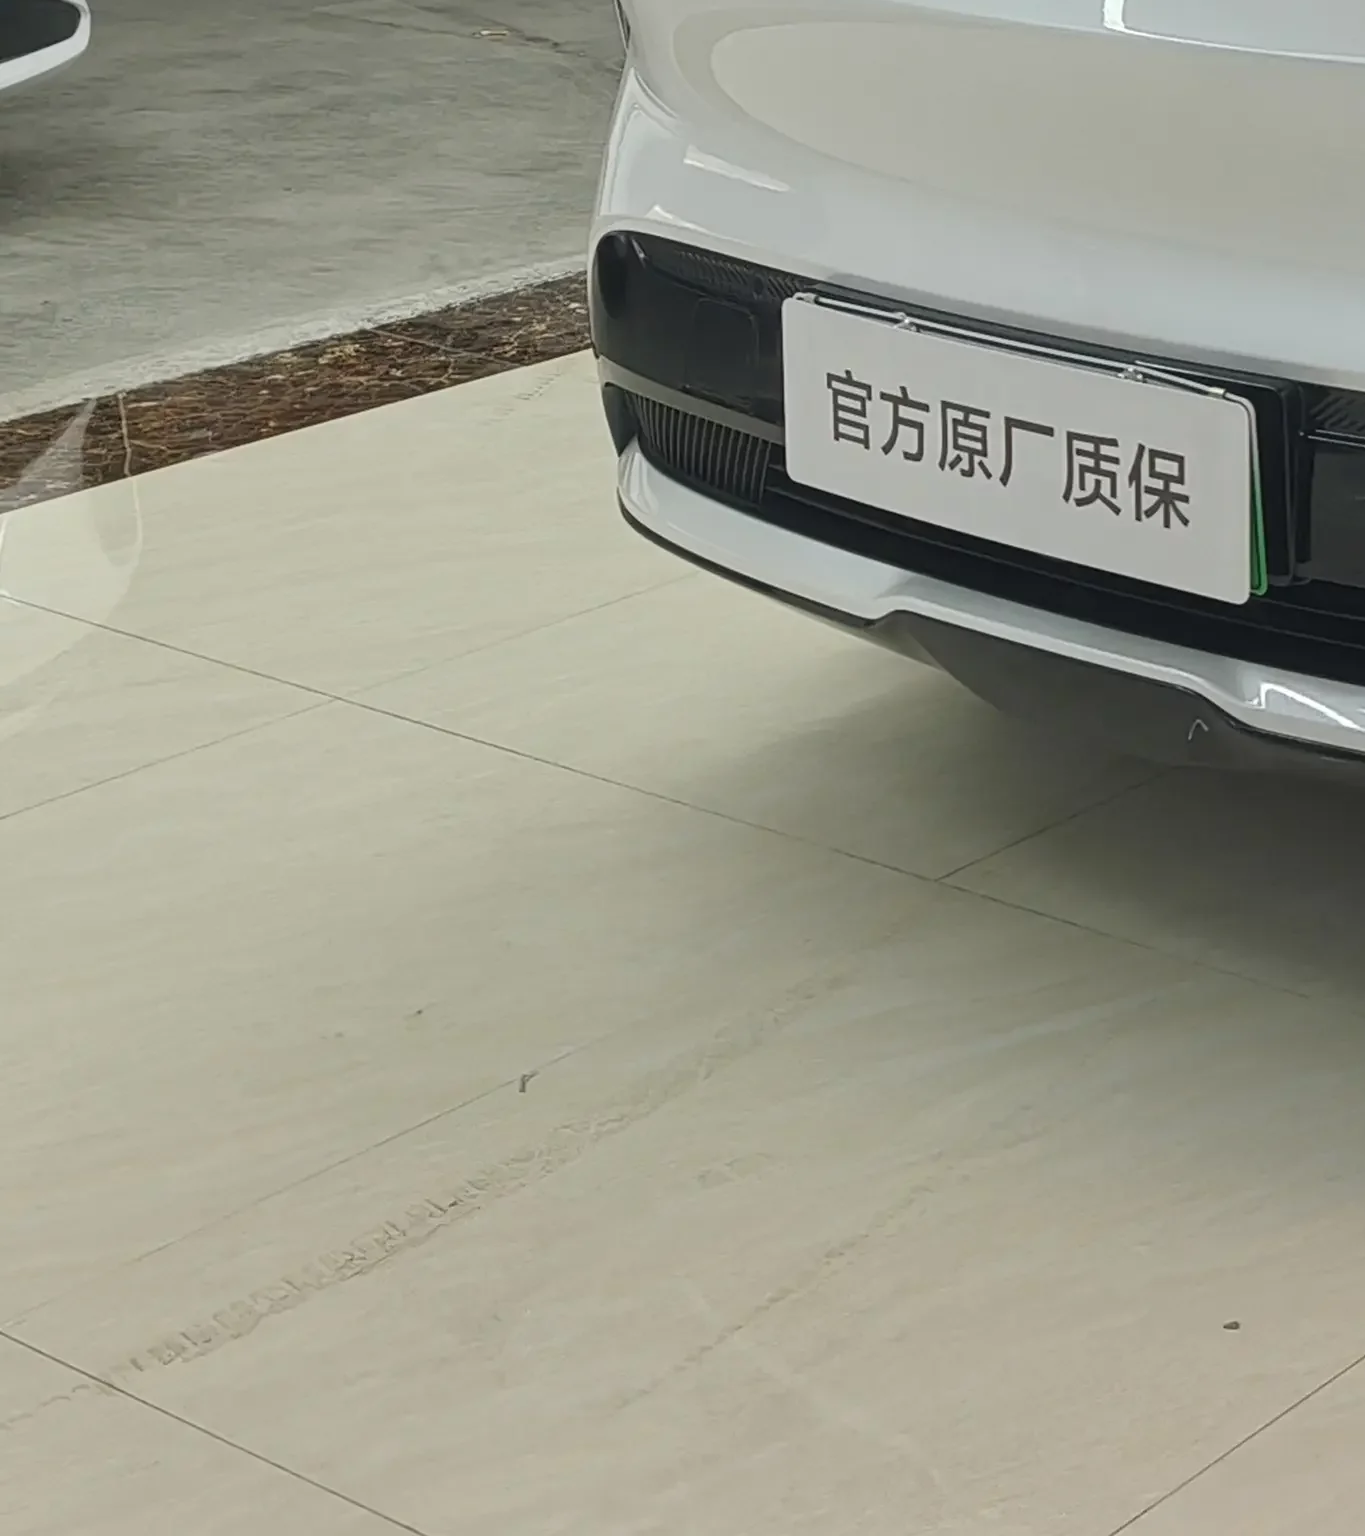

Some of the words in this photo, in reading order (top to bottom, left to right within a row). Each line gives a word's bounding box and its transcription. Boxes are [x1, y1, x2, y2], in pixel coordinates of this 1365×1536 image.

[826, 369, 1191, 530] 官方原厂质保
